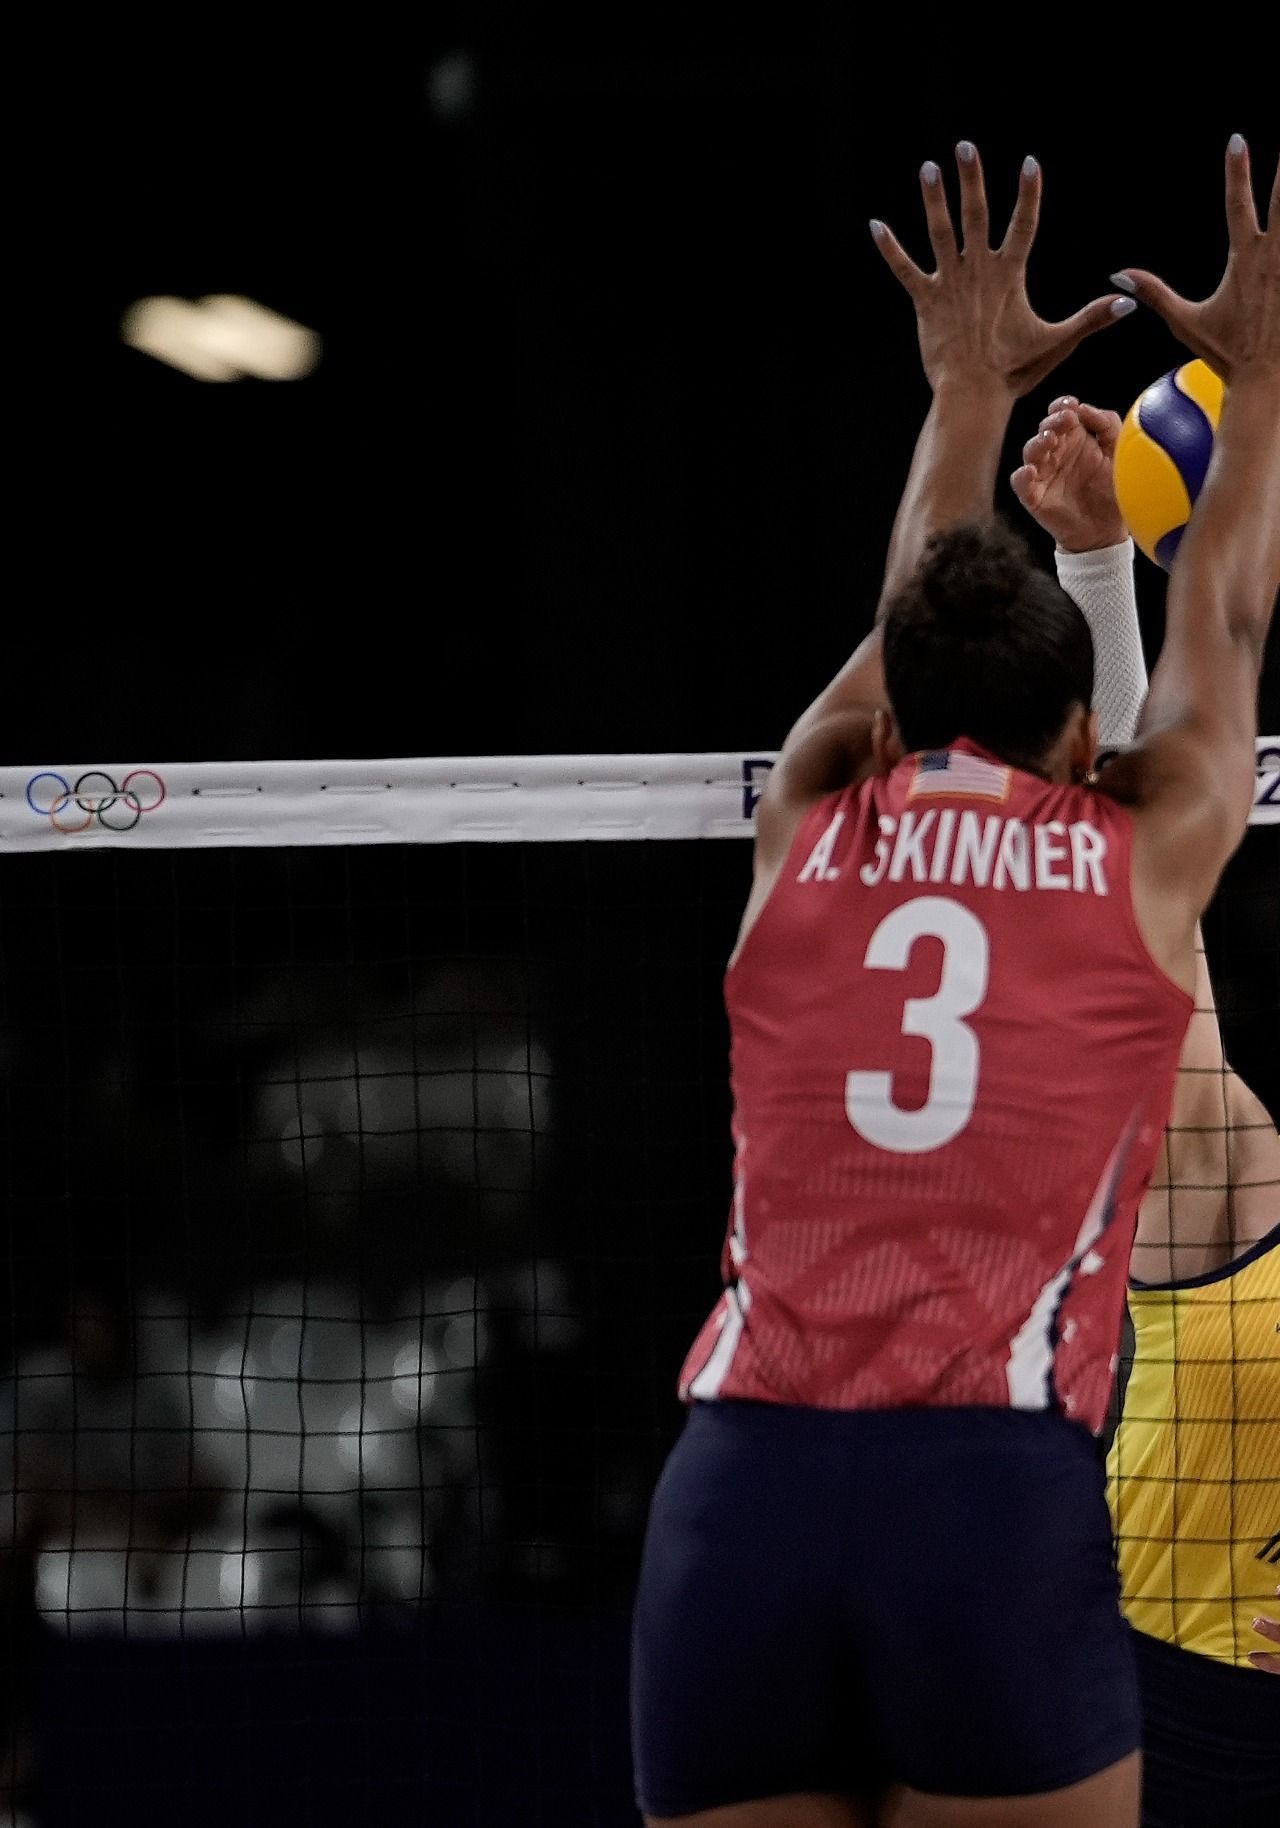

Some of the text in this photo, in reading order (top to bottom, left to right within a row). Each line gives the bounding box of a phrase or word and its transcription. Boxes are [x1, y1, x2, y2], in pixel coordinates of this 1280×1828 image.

[797, 808, 1108, 896] A. SKINNER
[844, 896, 989, 1153] 3
